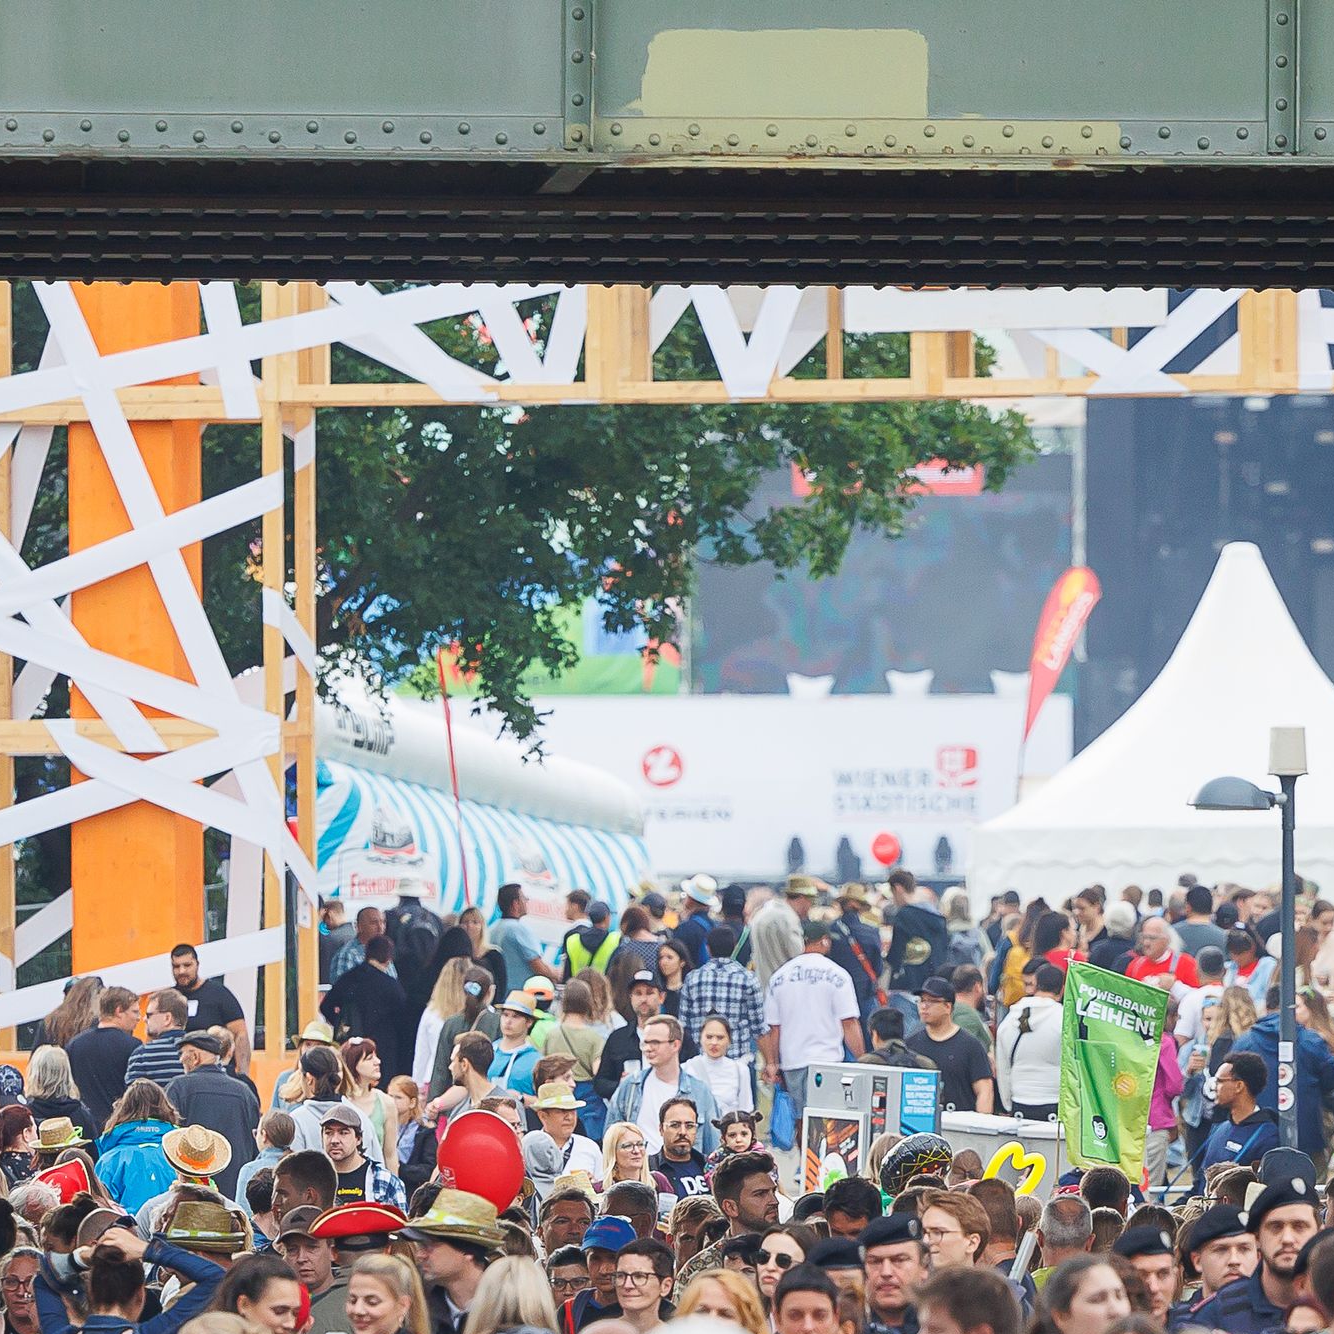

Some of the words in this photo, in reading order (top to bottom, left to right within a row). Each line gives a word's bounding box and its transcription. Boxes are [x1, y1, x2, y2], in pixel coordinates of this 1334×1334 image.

[834, 769, 931, 787] WIENER
[1076, 997, 1156, 1037] LEIHEN!
[1079, 983, 1157, 1017] POWERBANK
